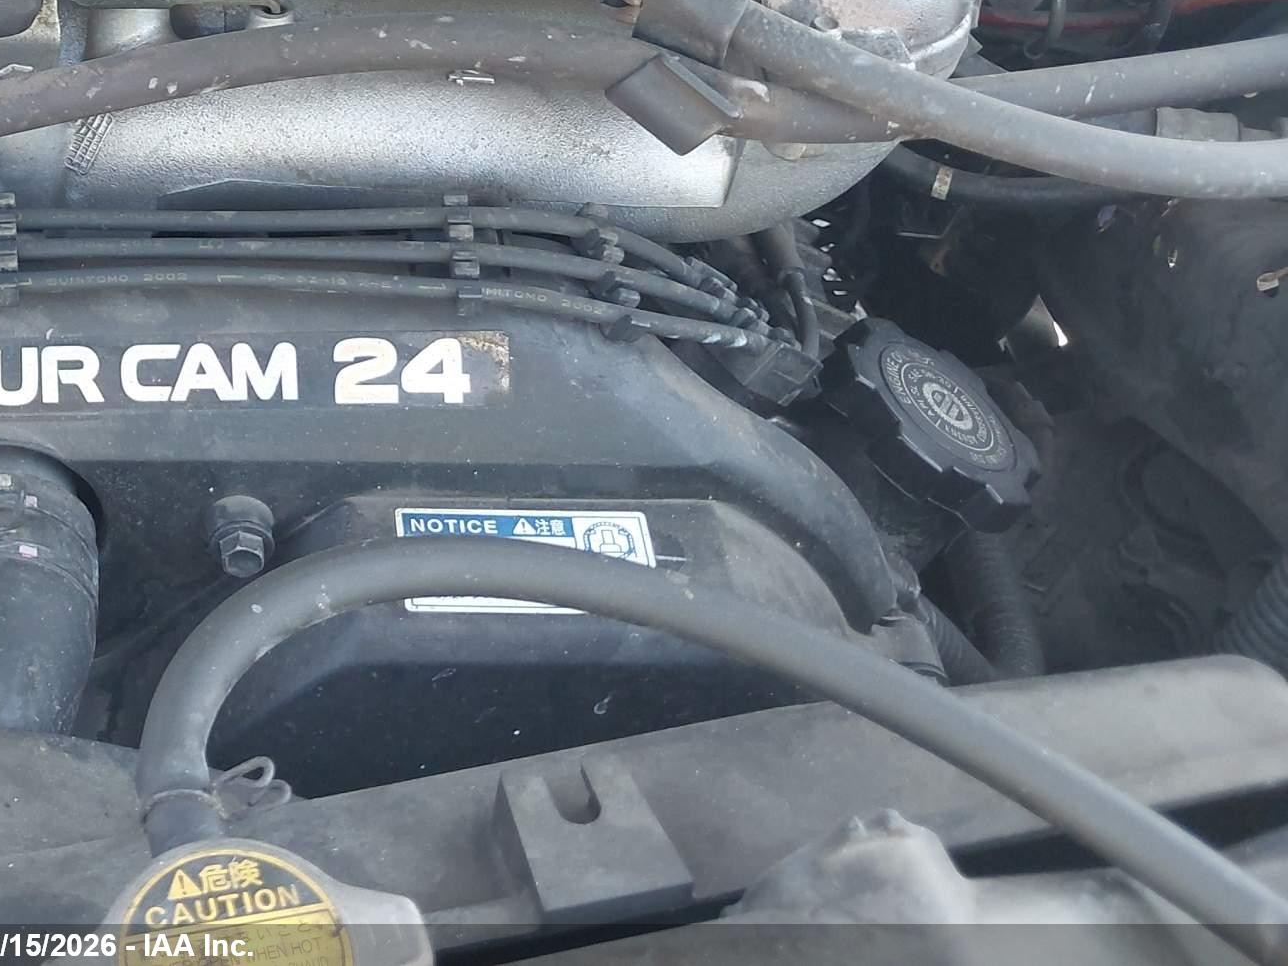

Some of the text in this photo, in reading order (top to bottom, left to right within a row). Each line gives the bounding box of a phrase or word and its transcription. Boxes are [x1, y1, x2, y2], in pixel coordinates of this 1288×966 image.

[143, 272, 188, 282] 2002
[120, 341, 299, 404] CAM
[332, 337, 471, 405] 24
[410, 518, 498, 534] NOTICE
[534, 518, 567, 536] 注意
[199, 859, 263, 895] 危険
[145, 883, 301, 930] CAUTION
